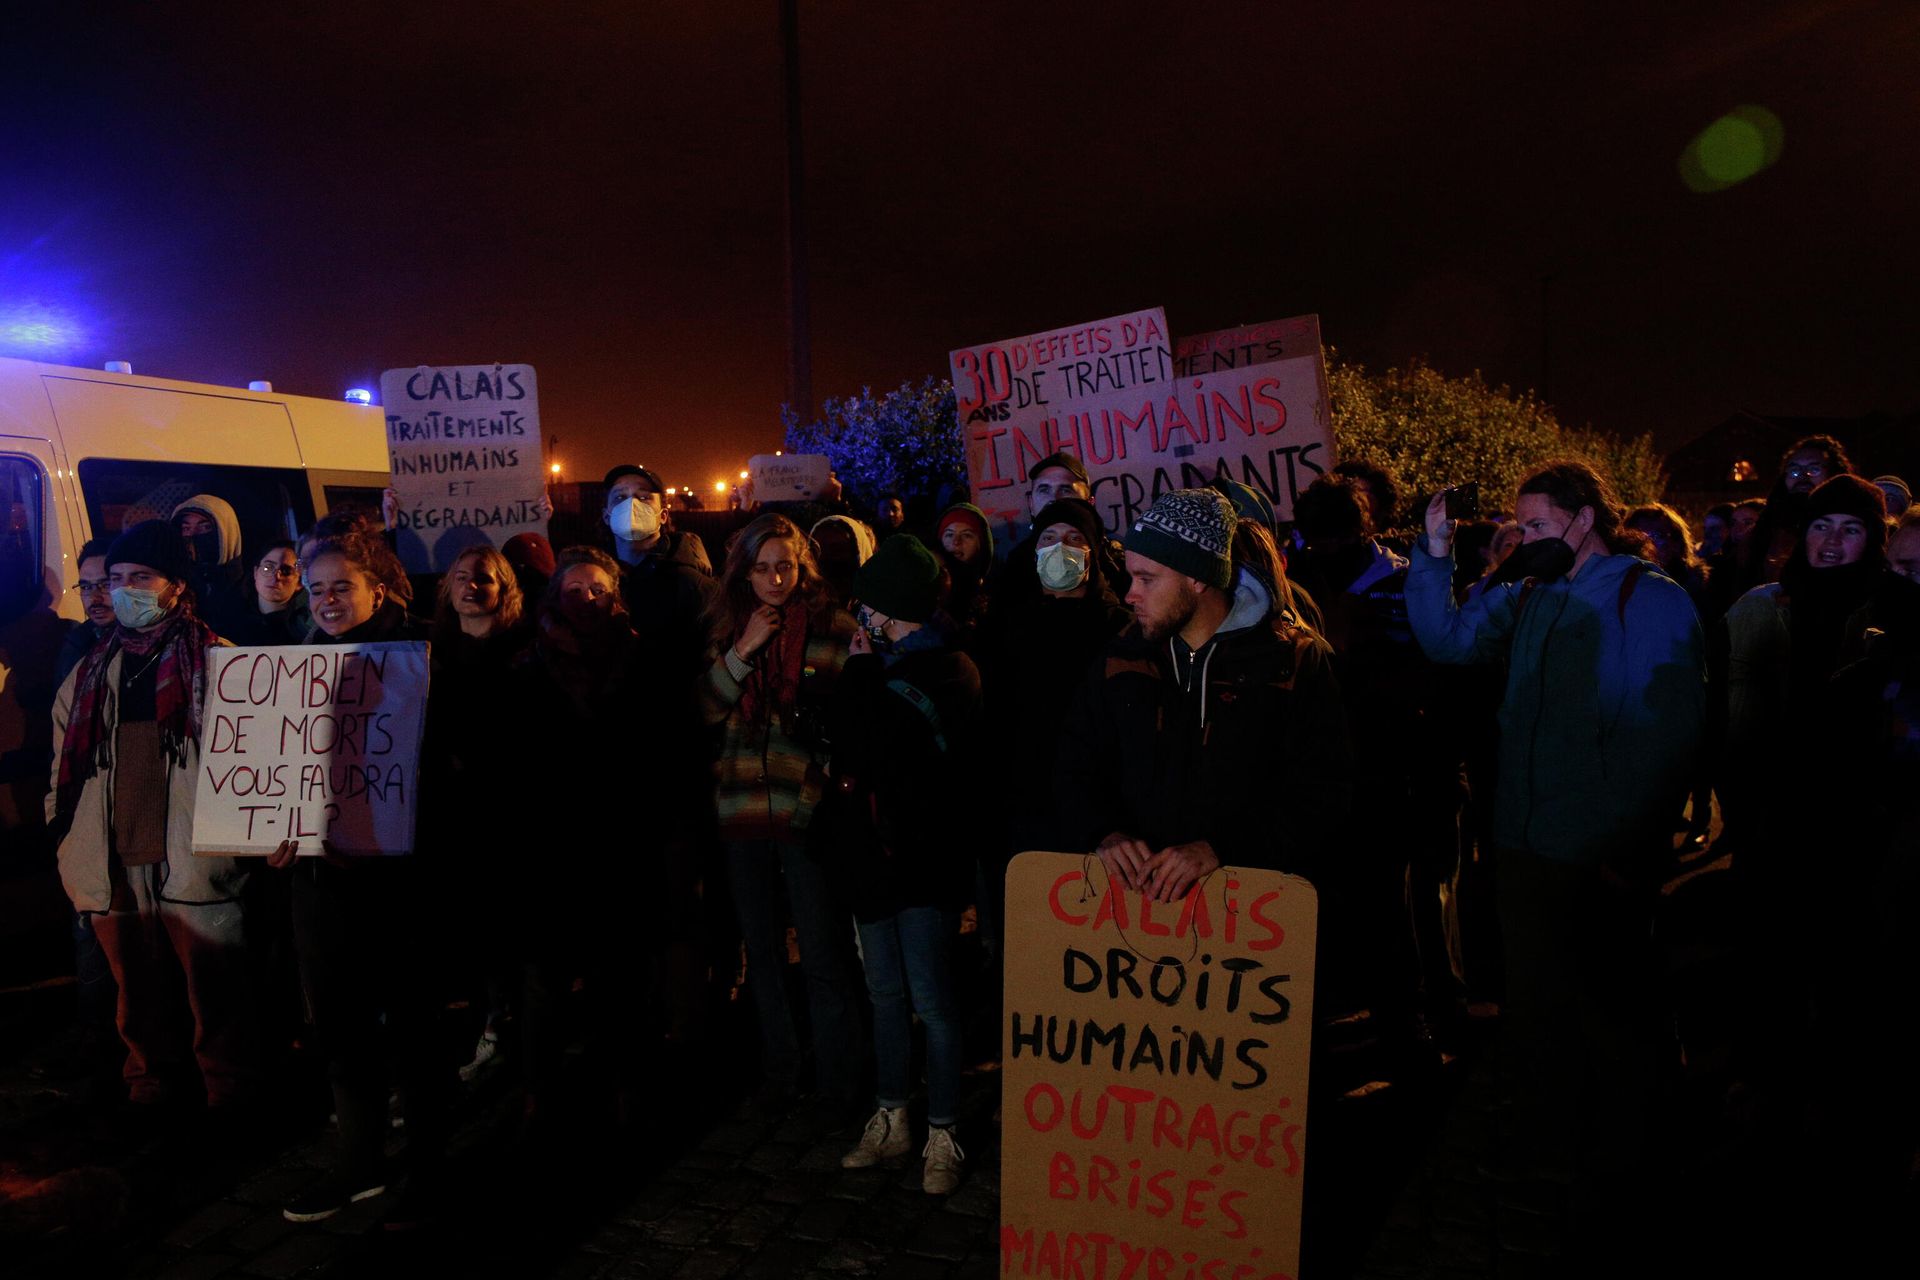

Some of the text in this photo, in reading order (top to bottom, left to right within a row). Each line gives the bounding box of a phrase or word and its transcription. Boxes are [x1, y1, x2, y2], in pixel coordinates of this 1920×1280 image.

[954, 347, 1012, 409] 30
[1011, 328, 1112, 371] D'EFFETS
[1014, 371, 1049, 409] DE
[967, 402, 1011, 424] ANS
[448, 481, 475, 496] ET
[397, 500, 541, 529] DÉGRADANTS
[217, 651, 388, 708] COMBIEN
[210, 713, 393, 755] DE MORTS
[206, 763, 404, 804] VOUS FAUDRA
[1024, 1082, 1300, 1177] OUTRAGÉS
[1000, 1224, 1293, 1280] MARTYRi
